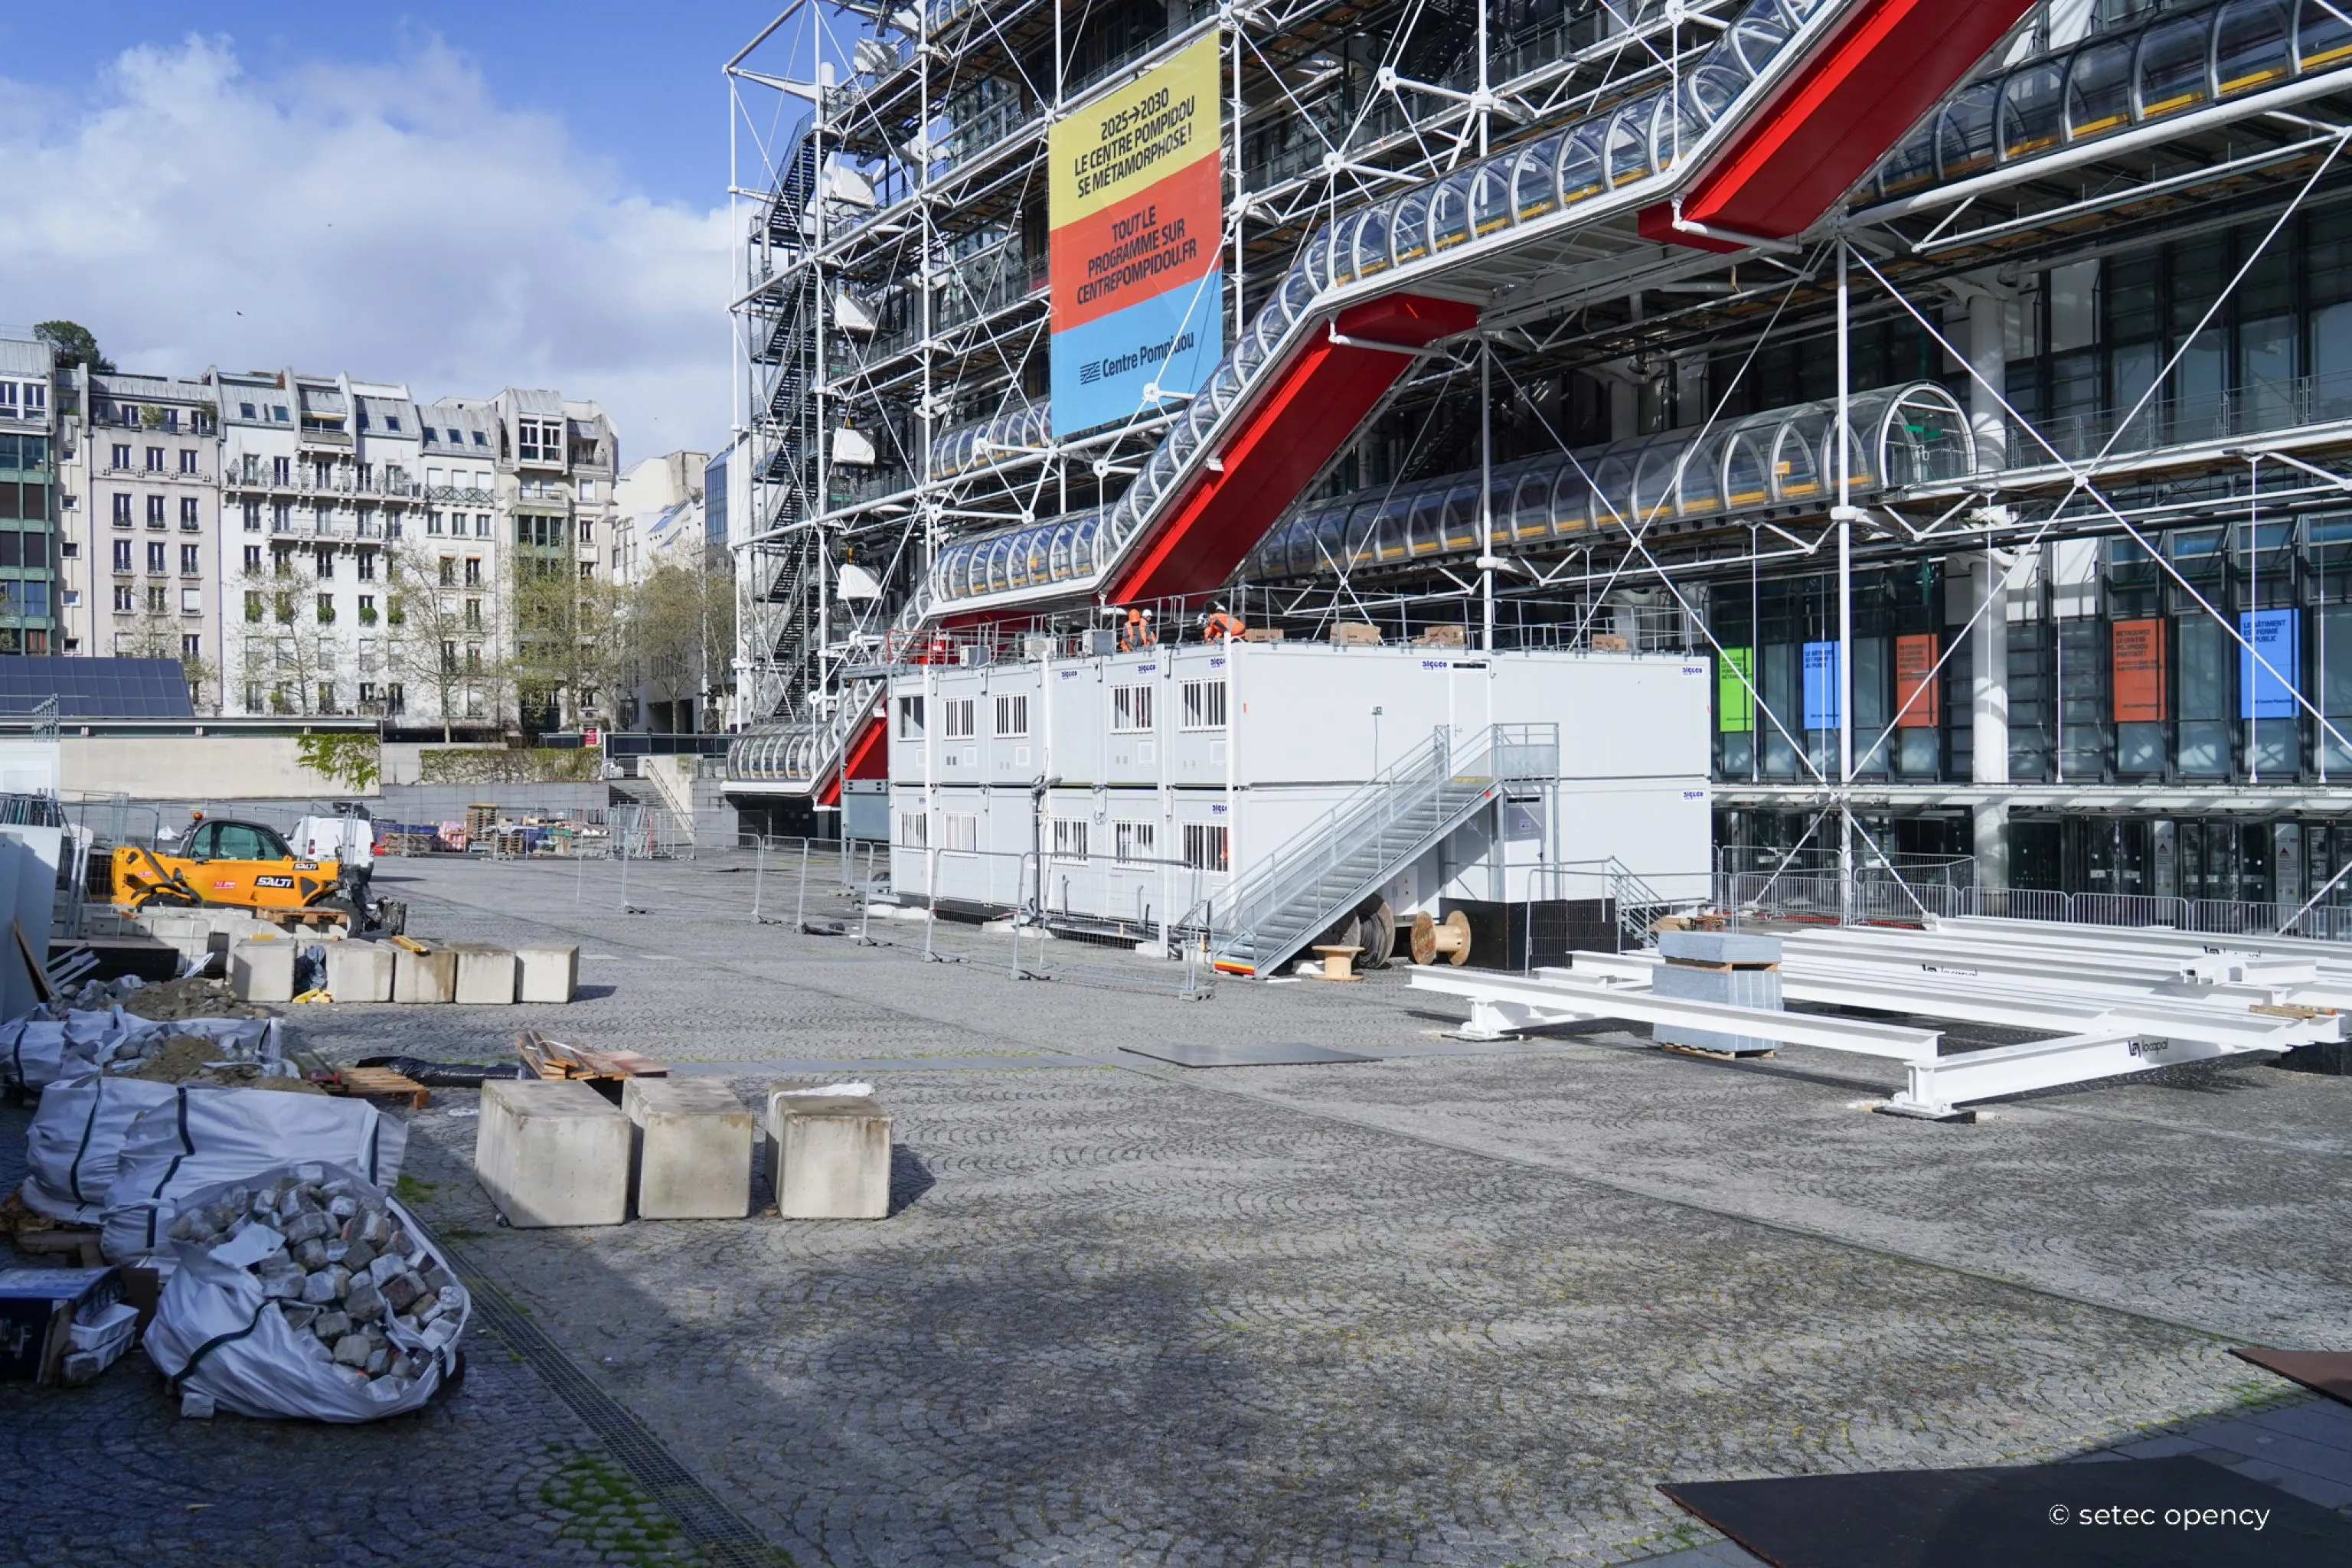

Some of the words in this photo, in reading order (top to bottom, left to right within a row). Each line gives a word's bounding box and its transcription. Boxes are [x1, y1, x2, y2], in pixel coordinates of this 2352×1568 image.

[1074, 153, 1088, 177] LE
[1090, 132, 1132, 168] CENTRE
[1135, 95, 1195, 148] POMPIDOU
[1078, 175, 1091, 198] SE
[1093, 124, 1186, 192] MÉTAMORPHOSE
[1088, 228, 1159, 279] PROGRAMME
[1161, 218, 1185, 247] SUR
[1112, 213, 1141, 243] TOUT
[1142, 205, 1156, 229] LE
[1077, 237, 1196, 305] CENTREPOMPIDOU.FR
[1102, 351, 1138, 377] Centre
[256, 877, 292, 887] SALTI
